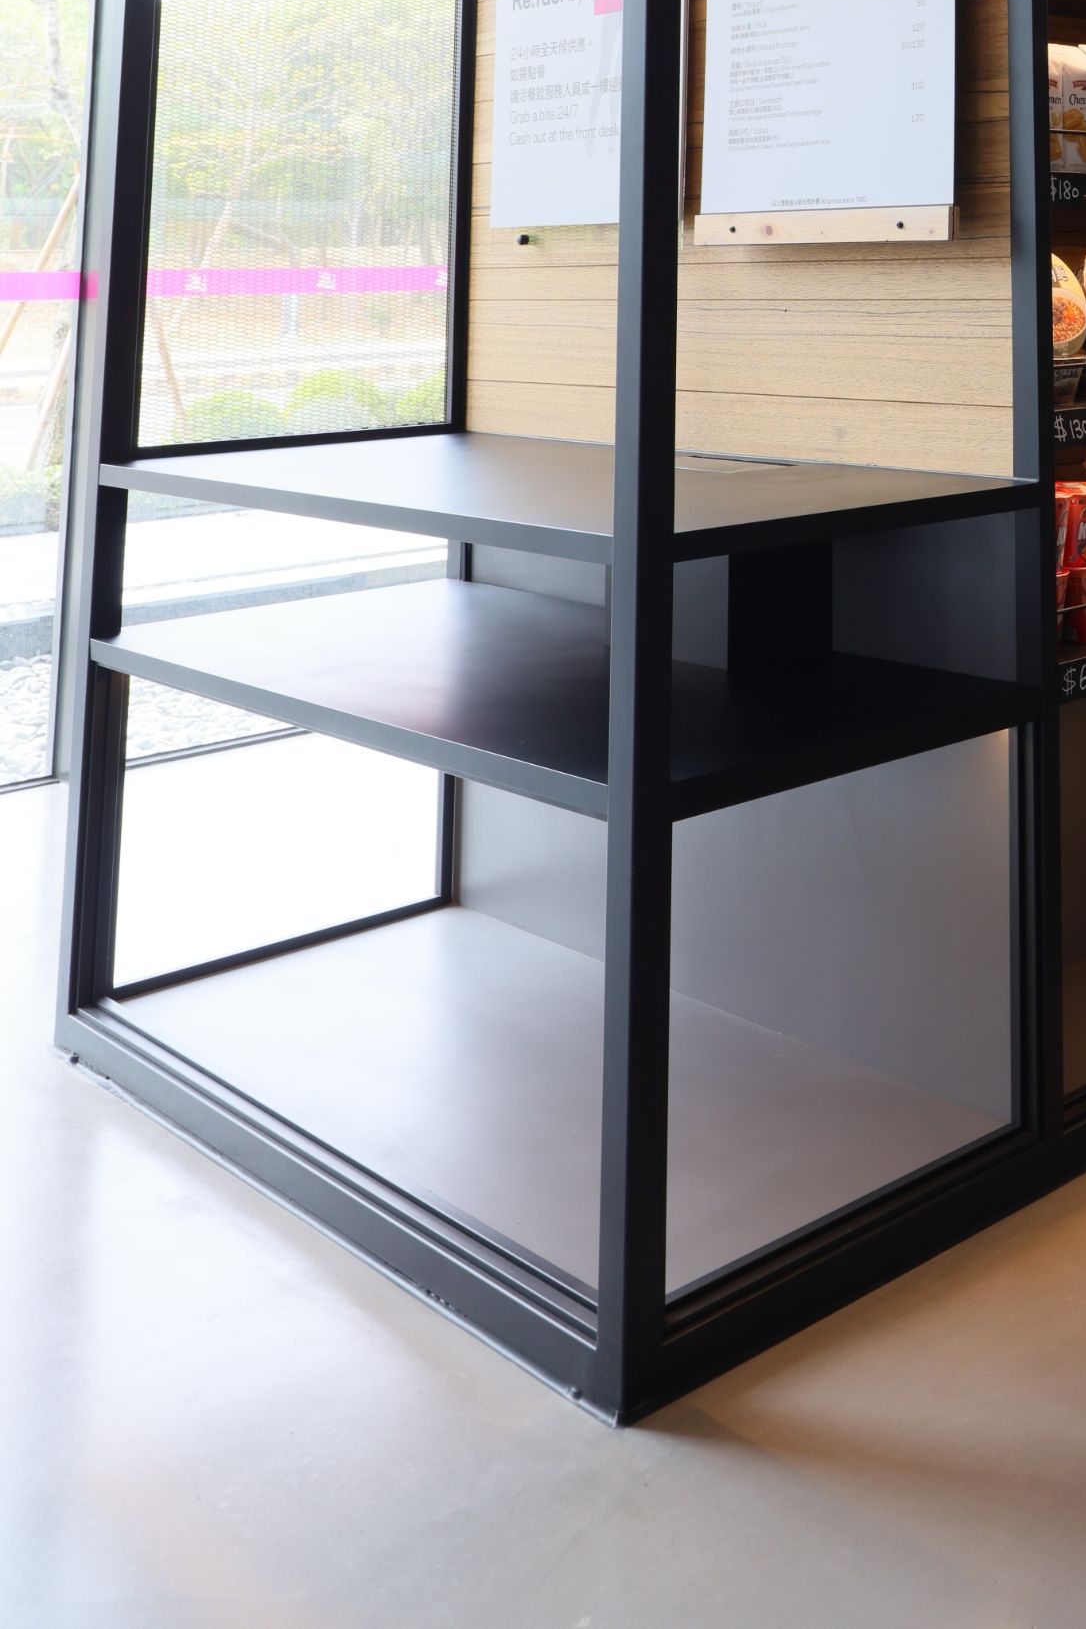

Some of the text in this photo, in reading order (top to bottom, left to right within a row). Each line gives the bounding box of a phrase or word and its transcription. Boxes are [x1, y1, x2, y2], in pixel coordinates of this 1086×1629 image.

[509, 108, 531, 124] Grab
[539, 107, 556, 121] bite
[557, 104, 579, 120] 24/7
[508, 131, 531, 146] Cash
[532, 132, 547, 144] out
[549, 131, 557, 143] at
[559, 127, 573, 141] the
[575, 124, 597, 140] front
[1050, 175, 1080, 202] $180
